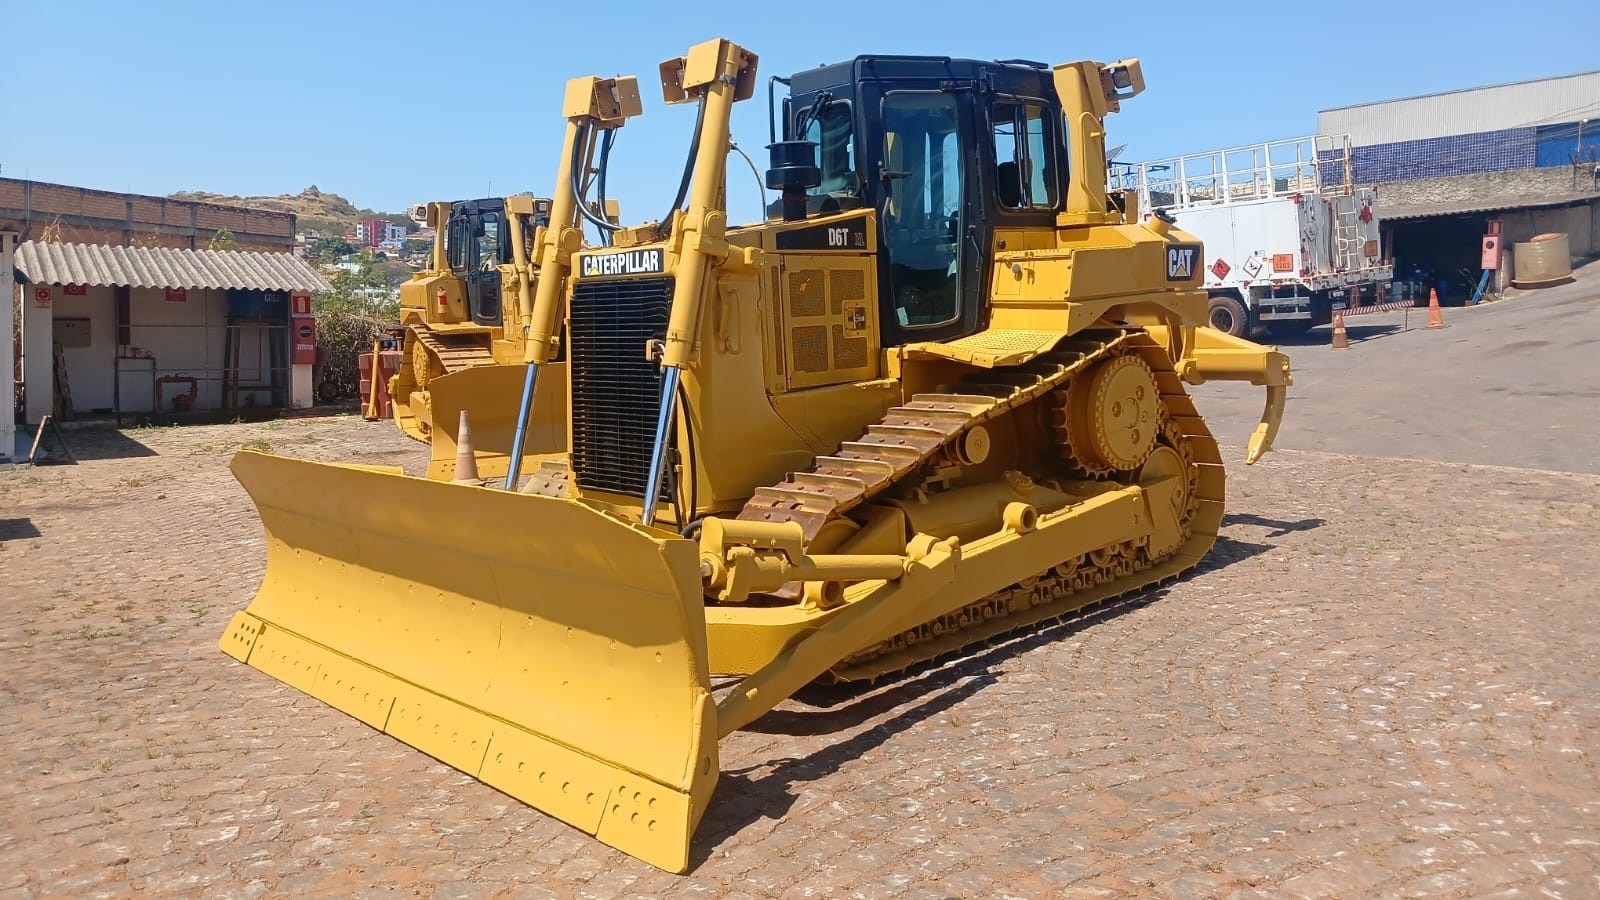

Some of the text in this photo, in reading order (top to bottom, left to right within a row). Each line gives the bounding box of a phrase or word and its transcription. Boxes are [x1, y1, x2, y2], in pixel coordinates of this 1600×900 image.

[828, 228, 849, 246] D6T
[584, 250, 659, 276] CATERPILLAR
[1168, 248, 1193, 277] CAT
